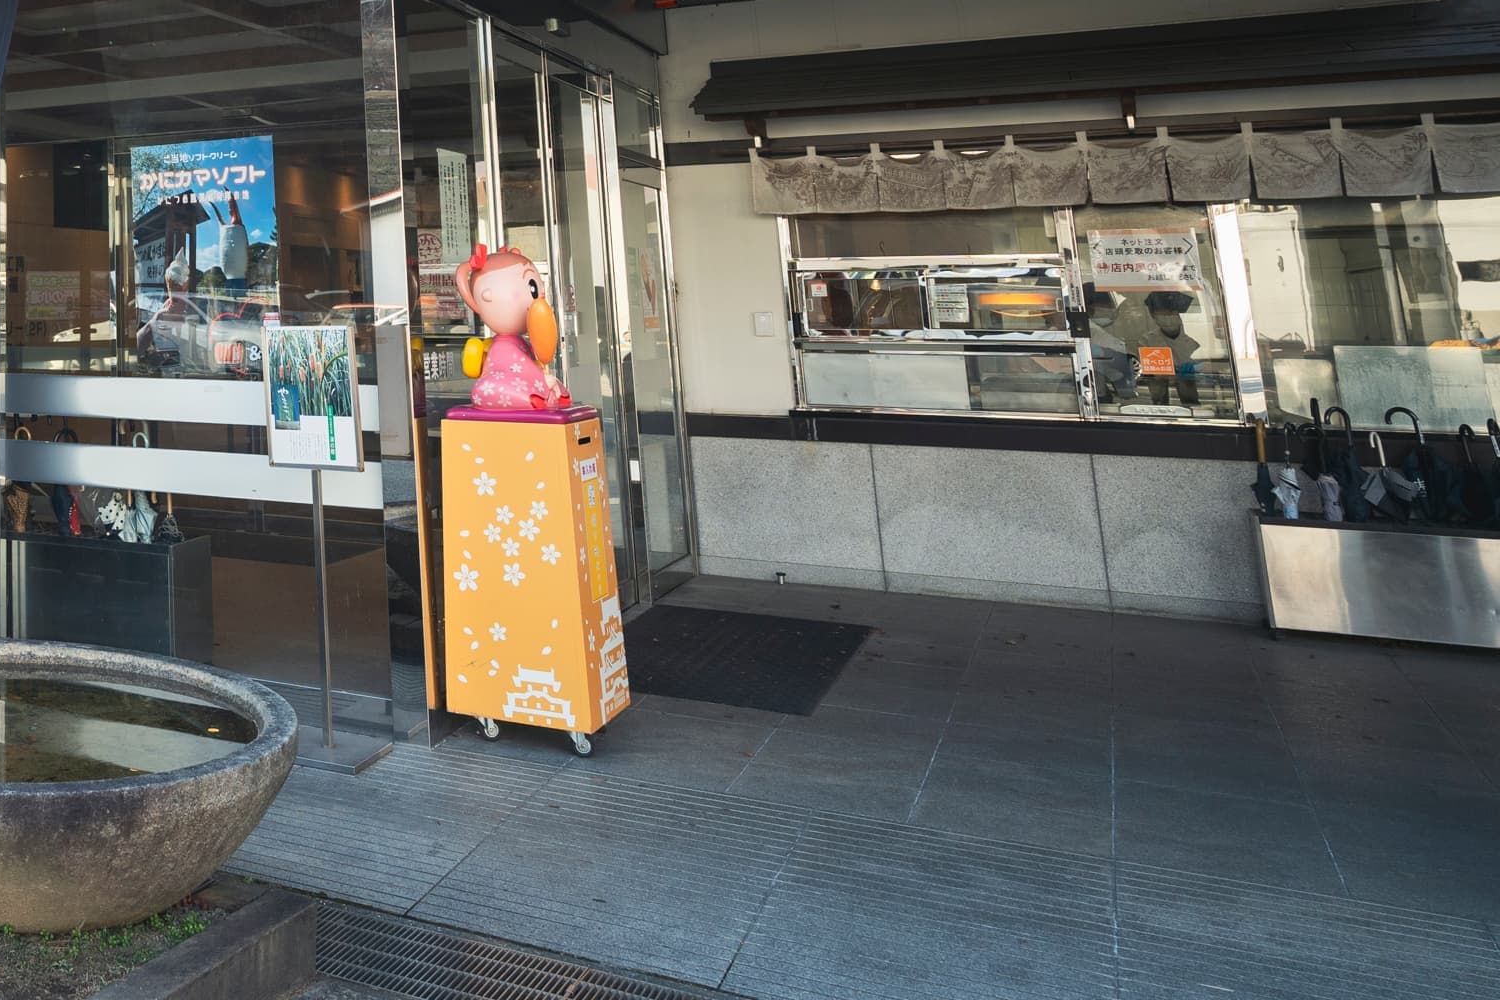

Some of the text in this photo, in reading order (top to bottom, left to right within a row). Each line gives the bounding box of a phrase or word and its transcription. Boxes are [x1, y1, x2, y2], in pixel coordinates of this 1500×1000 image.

[138, 164, 267, 191] かにカマソフト
[1105, 247, 1183, 256] 店頭受取のお客様
[1121, 238, 1164, 247] ネット注文
[423, 351, 453, 380] 営業時間
